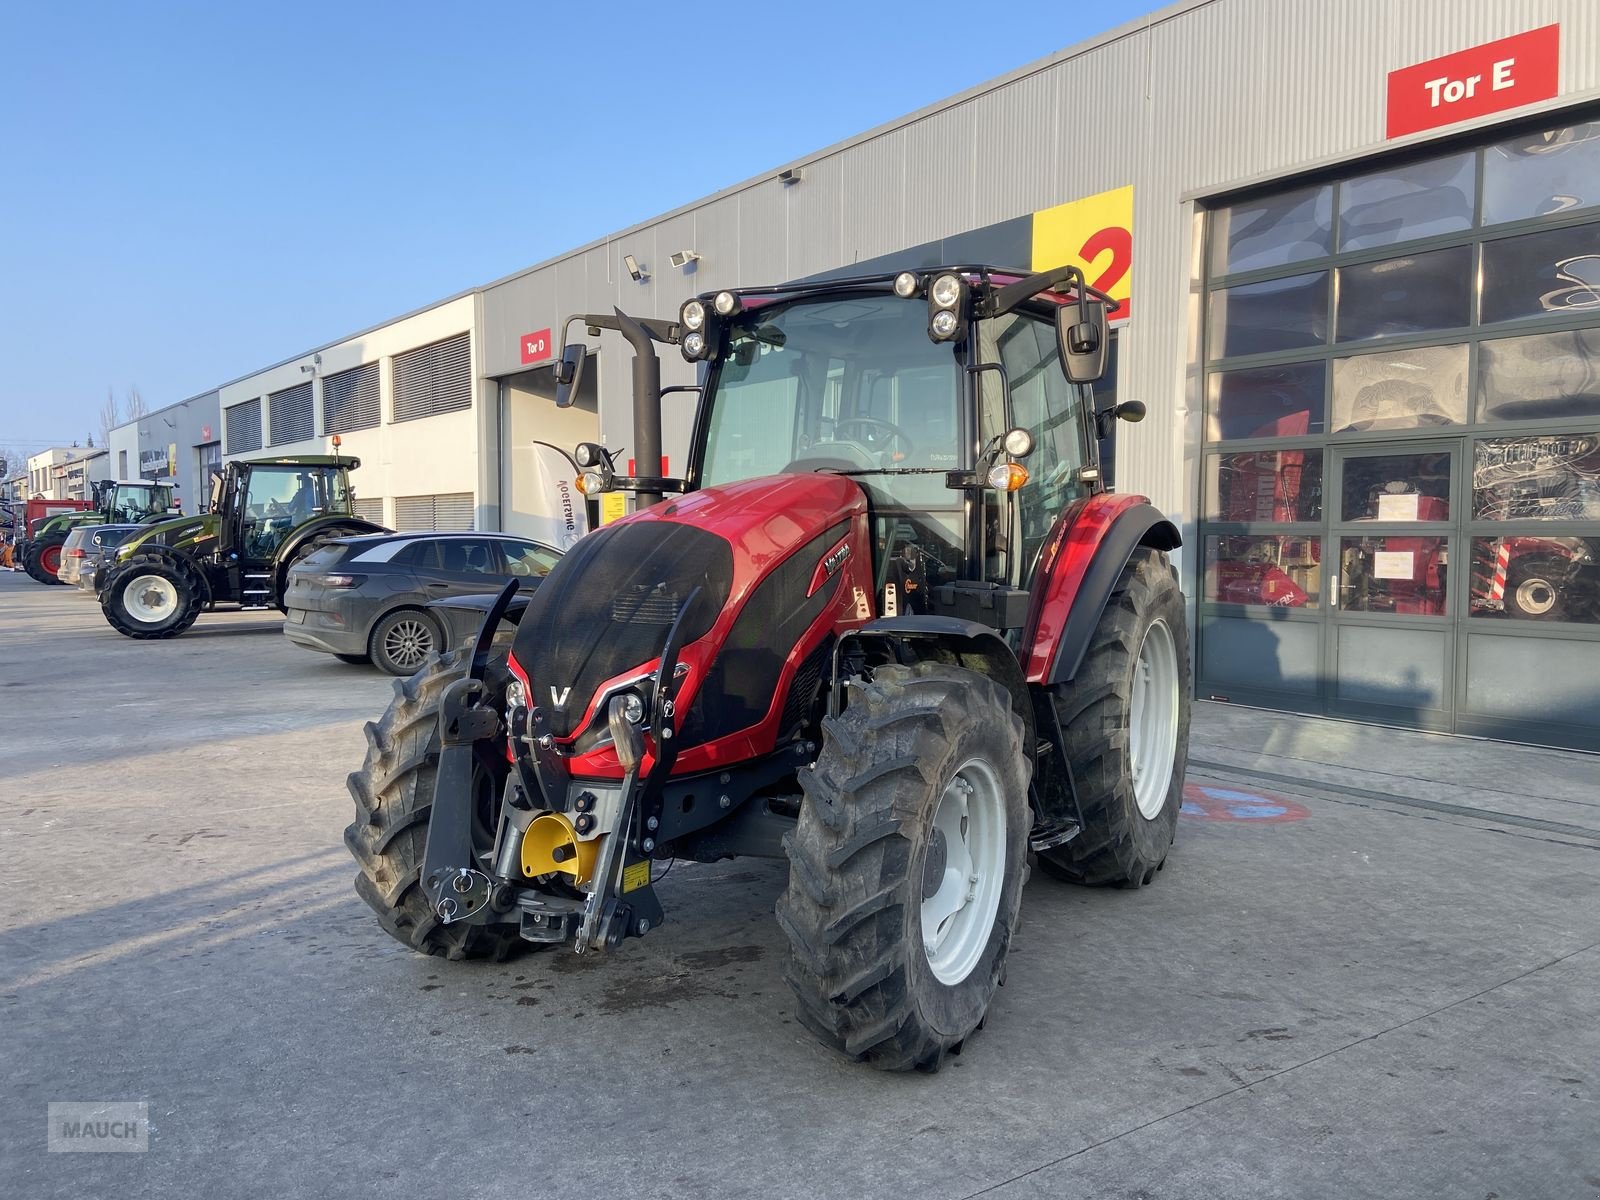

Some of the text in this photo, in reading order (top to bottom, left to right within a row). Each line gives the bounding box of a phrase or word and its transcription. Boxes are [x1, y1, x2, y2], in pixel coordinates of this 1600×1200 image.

[1425, 58, 1515, 108] Tor E
[1078, 226, 1133, 321] 2
[527, 339, 545, 355] Tor D
